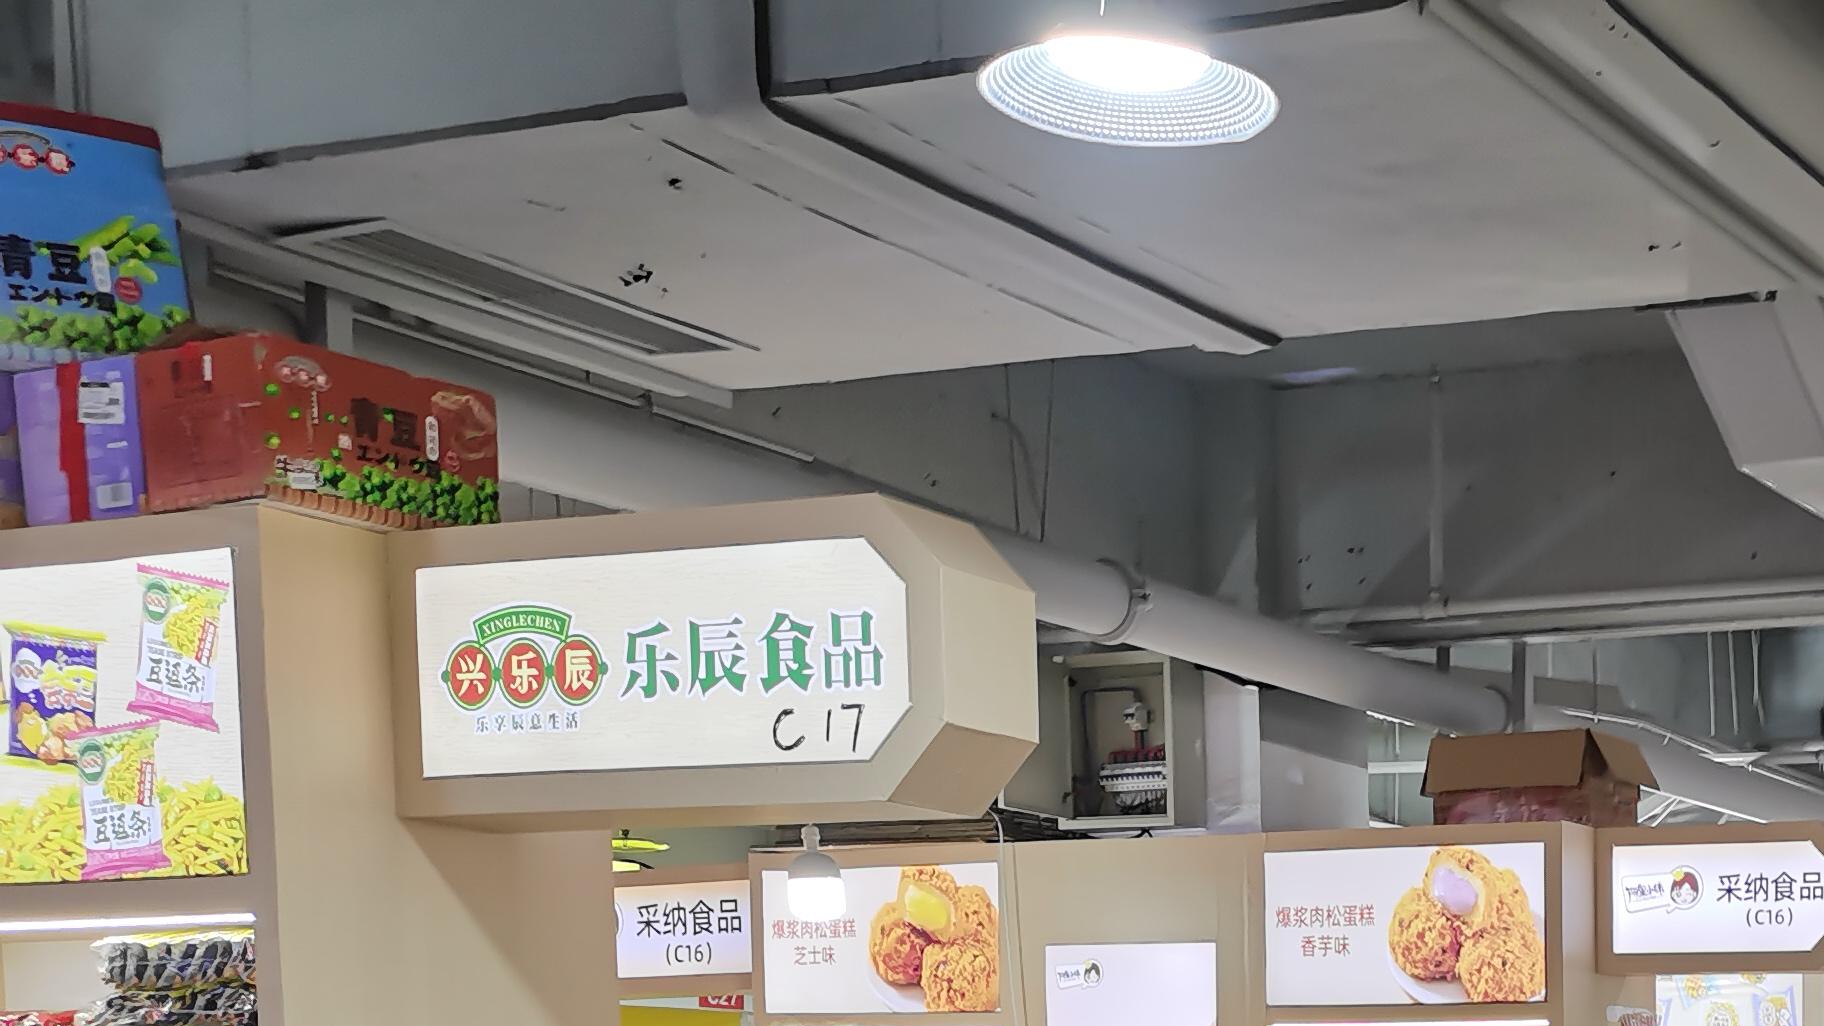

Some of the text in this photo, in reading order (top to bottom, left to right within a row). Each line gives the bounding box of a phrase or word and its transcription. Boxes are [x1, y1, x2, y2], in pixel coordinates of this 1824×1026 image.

[482, 614, 561, 637] XINGLECHEN
[621, 611, 883, 697] 乐辰食品
[456, 649, 594, 698] 兴乐辰
[1716, 871, 1824, 903] 采纳食品
[636, 899, 742, 938] 采纳食品
[1276, 904, 1375, 928] 爆浆肉松蛋糕
[1746, 908, 1793, 927] (C16)
[771, 919, 857, 939] 爆浆肉松蛋糕
[666, 942, 712, 966] (C16)
[794, 946, 836, 966] 芝士味
[1301, 934, 1351, 957] 香芋味
